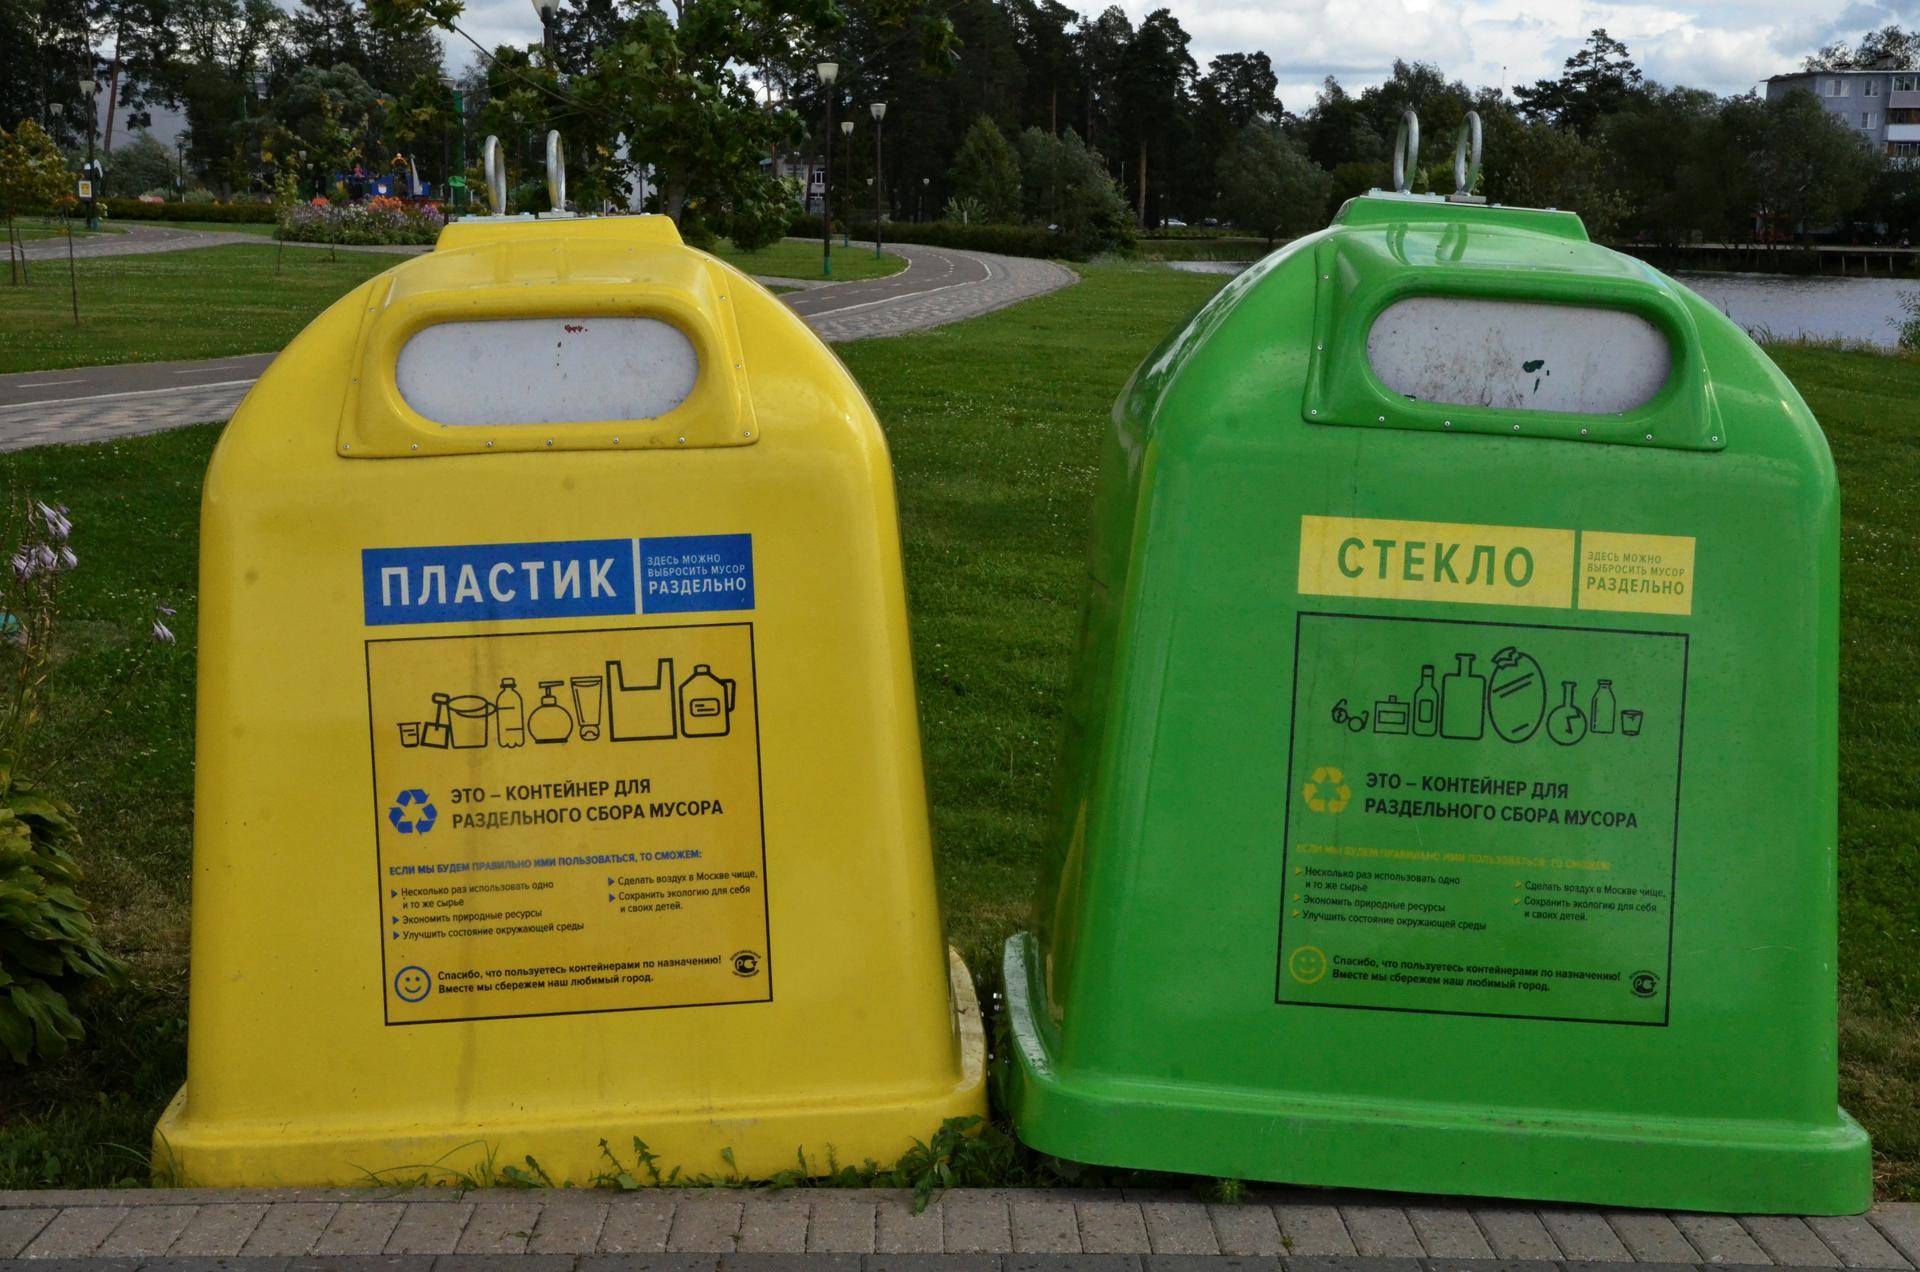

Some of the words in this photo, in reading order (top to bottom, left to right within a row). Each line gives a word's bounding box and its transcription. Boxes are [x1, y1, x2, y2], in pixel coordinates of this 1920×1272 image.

[648, 556, 679, 566] ЗДЕСЬ
[682, 554, 720, 564] МОЖНО
[1338, 537, 1534, 587] СТЕКЛО
[1587, 552, 1619, 562] ЗДЕСЬ
[1623, 553, 1662, 564] МОЖНО
[648, 566, 708, 577] ВЫБРОСИТЬ
[712, 564, 745, 574] МУСОР
[1587, 563, 1647, 575] ВЫБРОСИТЬ
[1650, 566, 1685, 577] МУСОР
[381, 558, 616, 606] ПЛАСТИК
[649, 577, 746, 596] РАЗДЕЛЬНО
[1587, 576, 1684, 595] РАЗДЕЛЬНО
[451, 788, 485, 804] ЭТО
[506, 780, 610, 800] КОНТЕЙНЕР
[614, 778, 651, 798] ДЛЯ
[1366, 772, 1401, 789] ЭТО
[1422, 776, 1526, 796] КОНТЕЙНЕР
[1531, 782, 1569, 800] ДЛЯ
[452, 807, 582, 830] РАЗДЕЛЬНОГО
[586, 804, 645, 821] СБОРА
[650, 800, 724, 818] МУСОРА
[1365, 798, 1496, 821] РАЗДЕЛЬНОГО
[1500, 806, 1560, 824] СБОРА
[1564, 809, 1638, 828] МУСОРА
[389, 866, 415, 876] ЕСЛИ
[418, 865, 434, 874] МЫ
[437, 863, 470, 874] БУДЕМ
[472, 860, 532, 871] ПРАВИЛЬНО
[534, 858, 556, 867] ИМИ
[558, 853, 638, 866] ПОЛЬЗОВАТЬСЯ,
[640, 852, 652, 861] ТО
[655, 850, 702, 861] СМОЖЕМ:
[618, 877, 654, 887] Сделать
[656, 875, 686, 885] воздух
[688, 874, 693, 882] в
[696, 872, 729, 880] Москве
[731, 870, 757, 880] чище,
[1305, 866, 1353, 878] Несколько
[1356, 871, 1372, 881] раз
[1374, 873, 1436, 884] использовать
[1438, 876, 1460, 885] одно
[401, 887, 448, 896] Несколько
[451, 886, 466, 896] раз
[469, 883, 530, 894] использовать
[532, 881, 554, 890] одно
[618, 892, 664, 902] Сохранить
[667, 888, 709, 899] экологию
[711, 888, 727, 896] для
[730, 885, 750, 894] себя
[1525, 881, 1562, 892] Сделать
[1564, 884, 1594, 894] воздух
[1604, 886, 1637, 895] Москве
[1640, 888, 1666, 898] чище,
[410, 901, 420, 909] то
[423, 900, 434, 908] же
[628, 904, 653, 912] своих
[655, 901, 683, 912] детей.
[1304, 895, 1352, 906] Экономить
[1355, 900, 1406, 911] природные
[1408, 902, 1446, 913] ресурсы
[1524, 896, 1570, 907] Сохранить
[1573, 901, 1615, 910] экологию
[1617, 903, 1633, 912] для
[1636, 902, 1656, 912] себя
[402, 914, 450, 925] Экономить
[452, 912, 503, 923] природные
[505, 910, 542, 921] ресурсы
[1302, 910, 1346, 922] Улучшить
[1348, 915, 1394, 925] состояние
[1397, 918, 1456, 928] окружающей
[1458, 921, 1486, 931] среды
[1559, 911, 1588, 921] детей.
[403, 930, 446, 941] Улучшить
[448, 928, 494, 937] состояние
[496, 923, 554, 936] окружающей
[556, 922, 585, 933] среды
[438, 970, 483, 980] Спасибо,
[485, 970, 502, 978] что
[505, 966, 566, 978] пользуетесь
[569, 960, 640, 972] контейнерами
[643, 961, 655, 969] по
[658, 955, 721, 967] назначению!
[1333, 955, 1379, 968] Спасибо,
[1382, 960, 1398, 968] что
[1401, 960, 1464, 972] пользуетесь
[1466, 966, 1538, 977] контейнерами
[1541, 968, 1552, 977] по
[1556, 971, 1621, 982] назначению!
[438, 984, 474, 994] Вместе
[477, 983, 492, 991] мы
[495, 980, 545, 992] сбережем
[548, 979, 568, 988] наш
[571, 974, 619, 986] любимый
[622, 974, 654, 984] город.
[1333, 969, 1368, 980] Вместе
[1371, 973, 1387, 981] мы
[1390, 972, 1440, 985] сбережем
[1443, 977, 1463, 985] наш
[1466, 978, 1516, 988] любимый
[1518, 980, 1550, 991] город.
